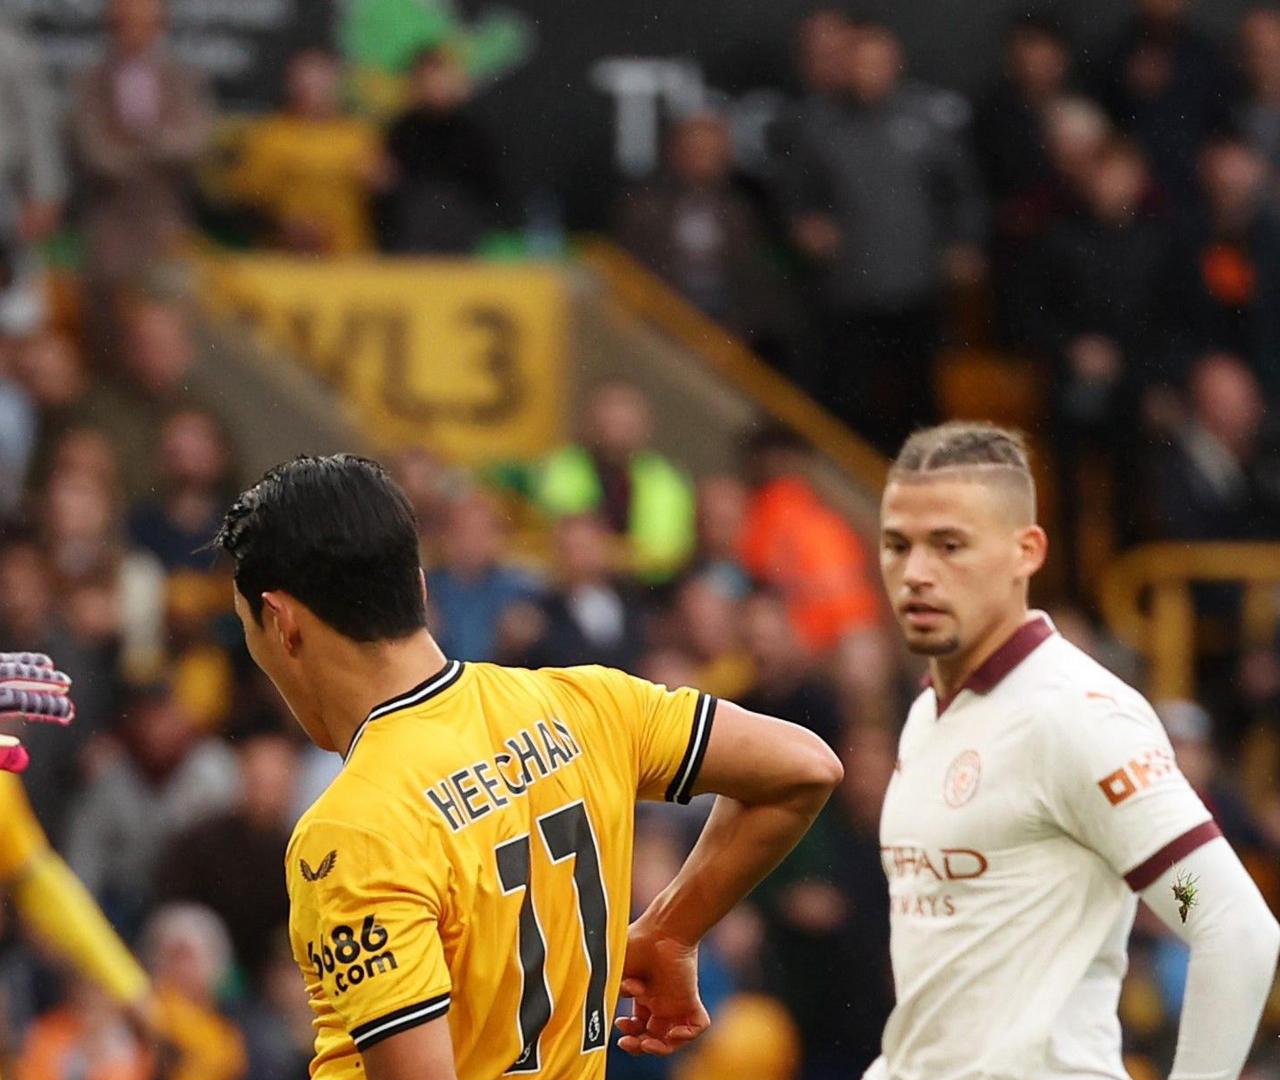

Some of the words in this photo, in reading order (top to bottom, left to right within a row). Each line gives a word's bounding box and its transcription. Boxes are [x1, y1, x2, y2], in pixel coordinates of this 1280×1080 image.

[425, 719, 581, 832] HEECHAN
[307, 913, 389, 981] 6686
[334, 949, 399, 997] .com
[494, 799, 609, 1078] 11
